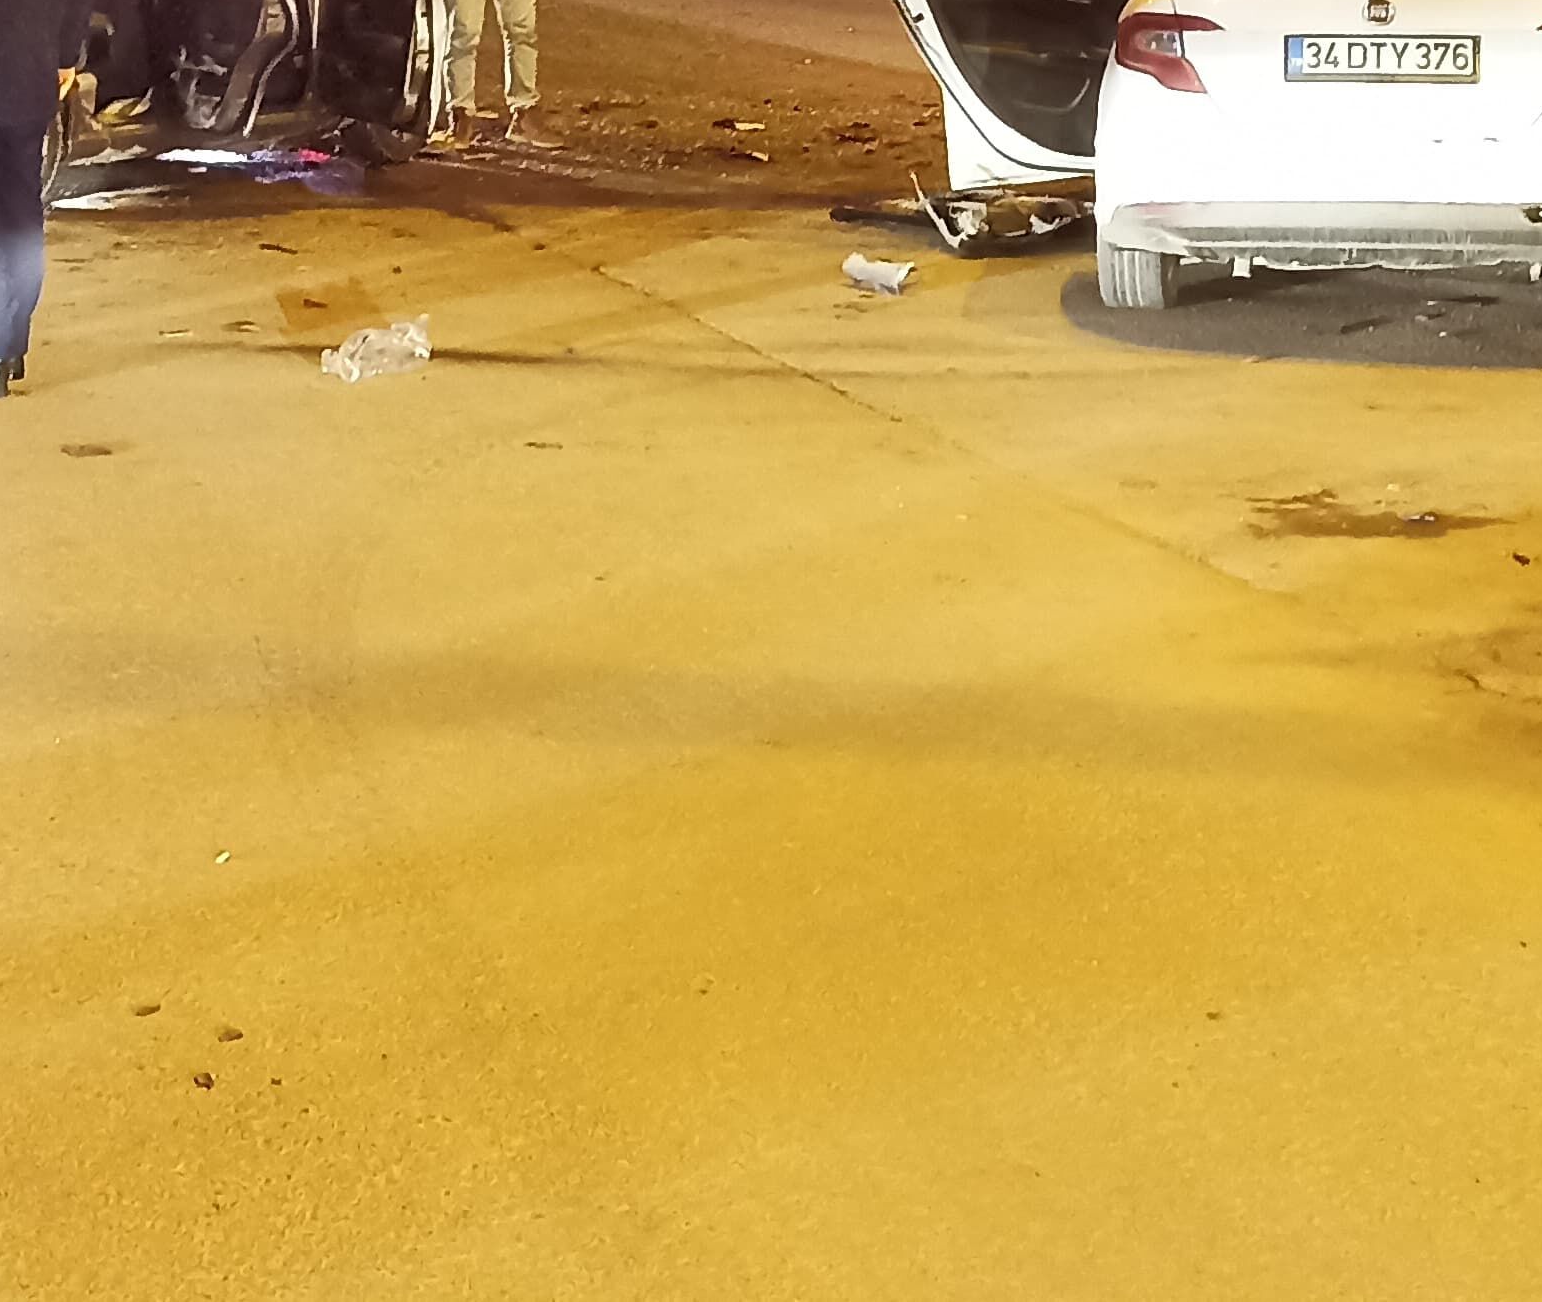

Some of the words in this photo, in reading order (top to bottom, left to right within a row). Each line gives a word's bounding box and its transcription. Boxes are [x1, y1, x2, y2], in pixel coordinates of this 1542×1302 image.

[1306, 41, 1340, 69] 34
[1347, 41, 1410, 69] DTY
[1415, 41, 1469, 71] 376
